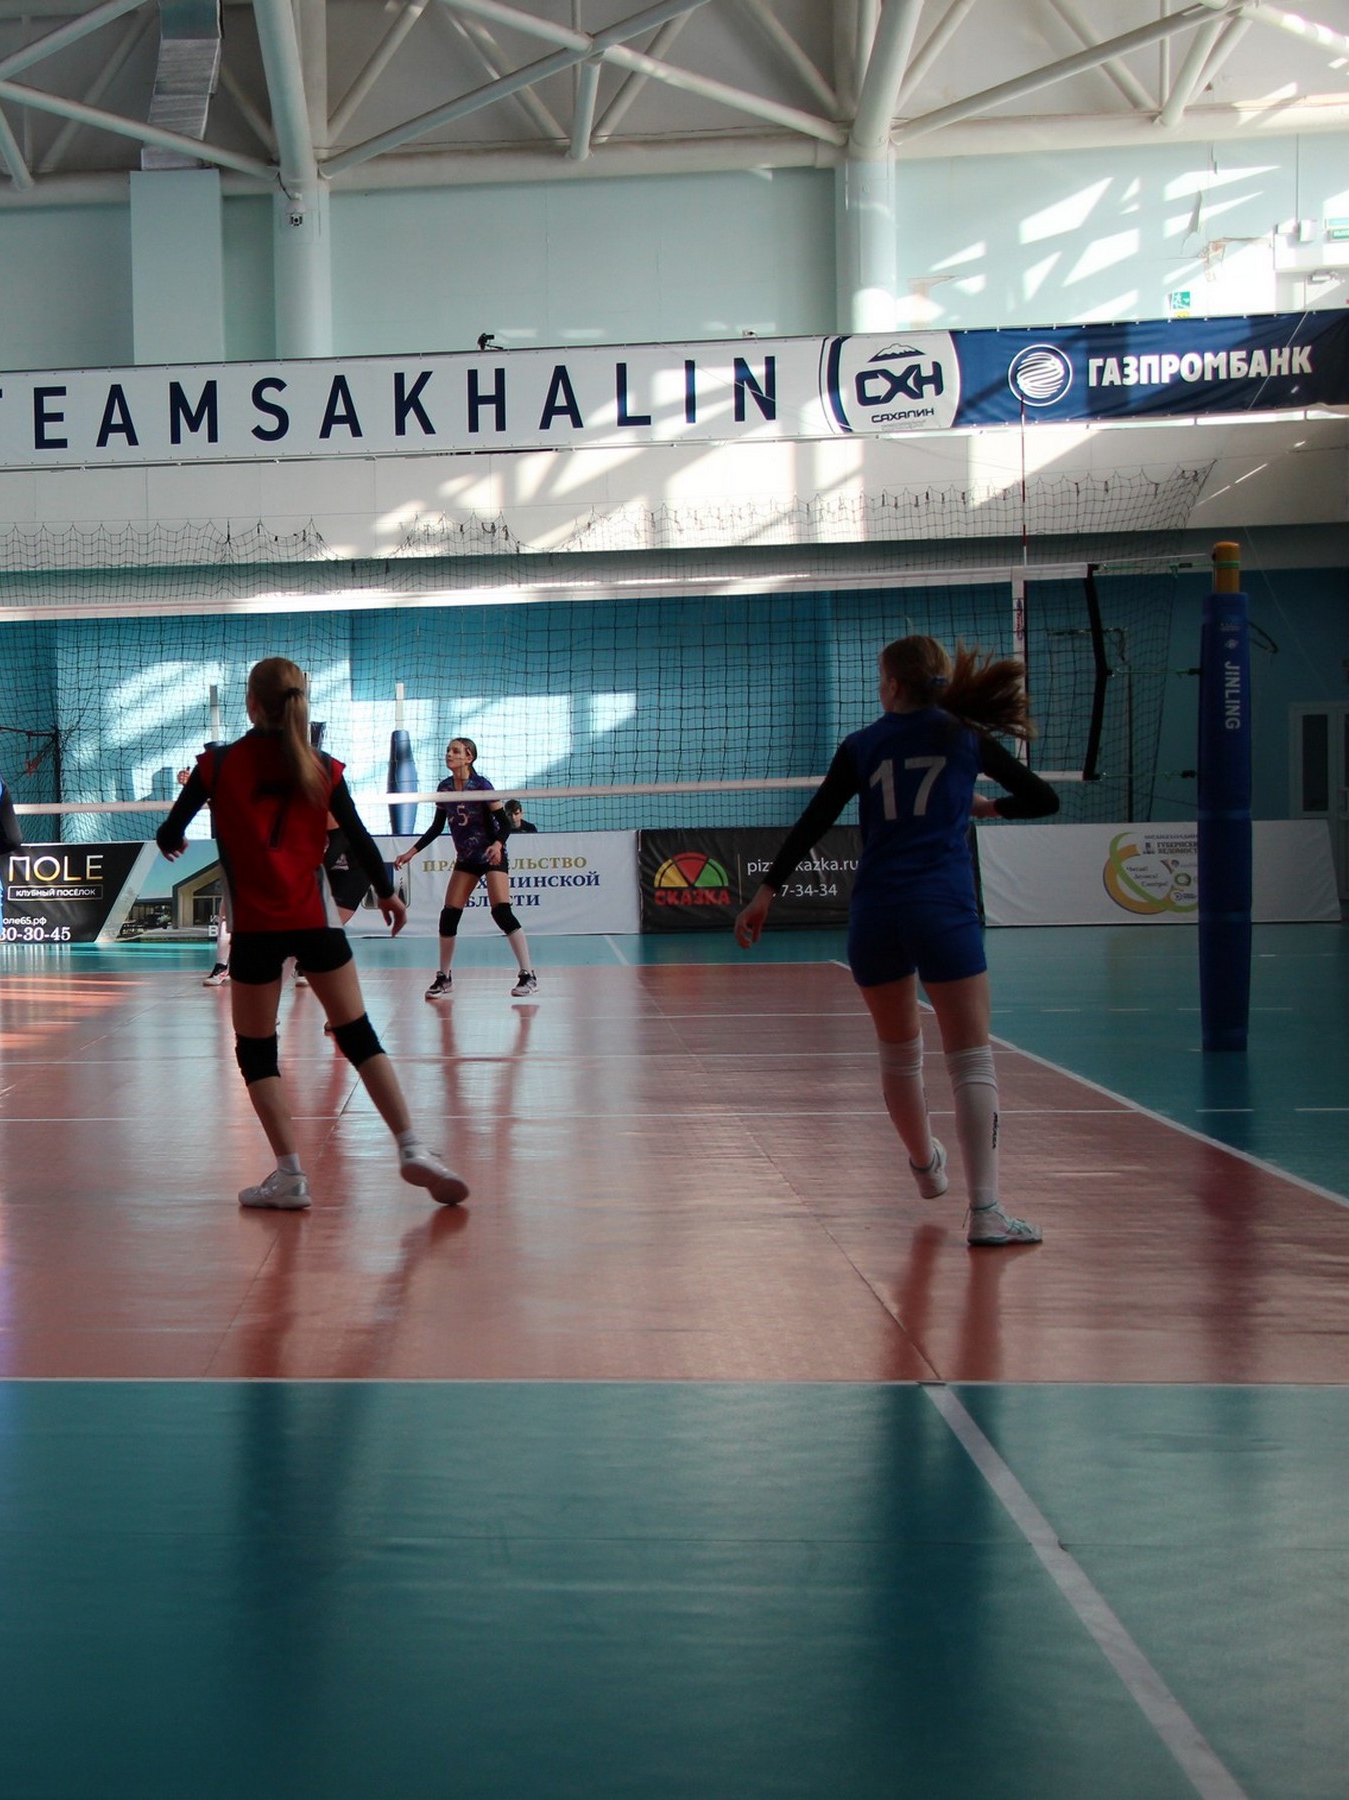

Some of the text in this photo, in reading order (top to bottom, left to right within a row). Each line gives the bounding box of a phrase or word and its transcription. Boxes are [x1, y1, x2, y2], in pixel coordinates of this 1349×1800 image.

[1088, 346, 1313, 388] ГАЗПРОМБАНК
[871, 408, 935, 423] САХАЛИН
[1224, 660, 1241, 730] JINLING
[869, 755, 947, 821] 17
[456, 805, 468, 827] 5
[423, 857, 587, 872] ПРАЛЬСТВО
[15, 888, 55, 897] КЛУБНЫЙ
[654, 888, 731, 906] СКАЗКА
[2, 916, 48, 926] оле65.рф
